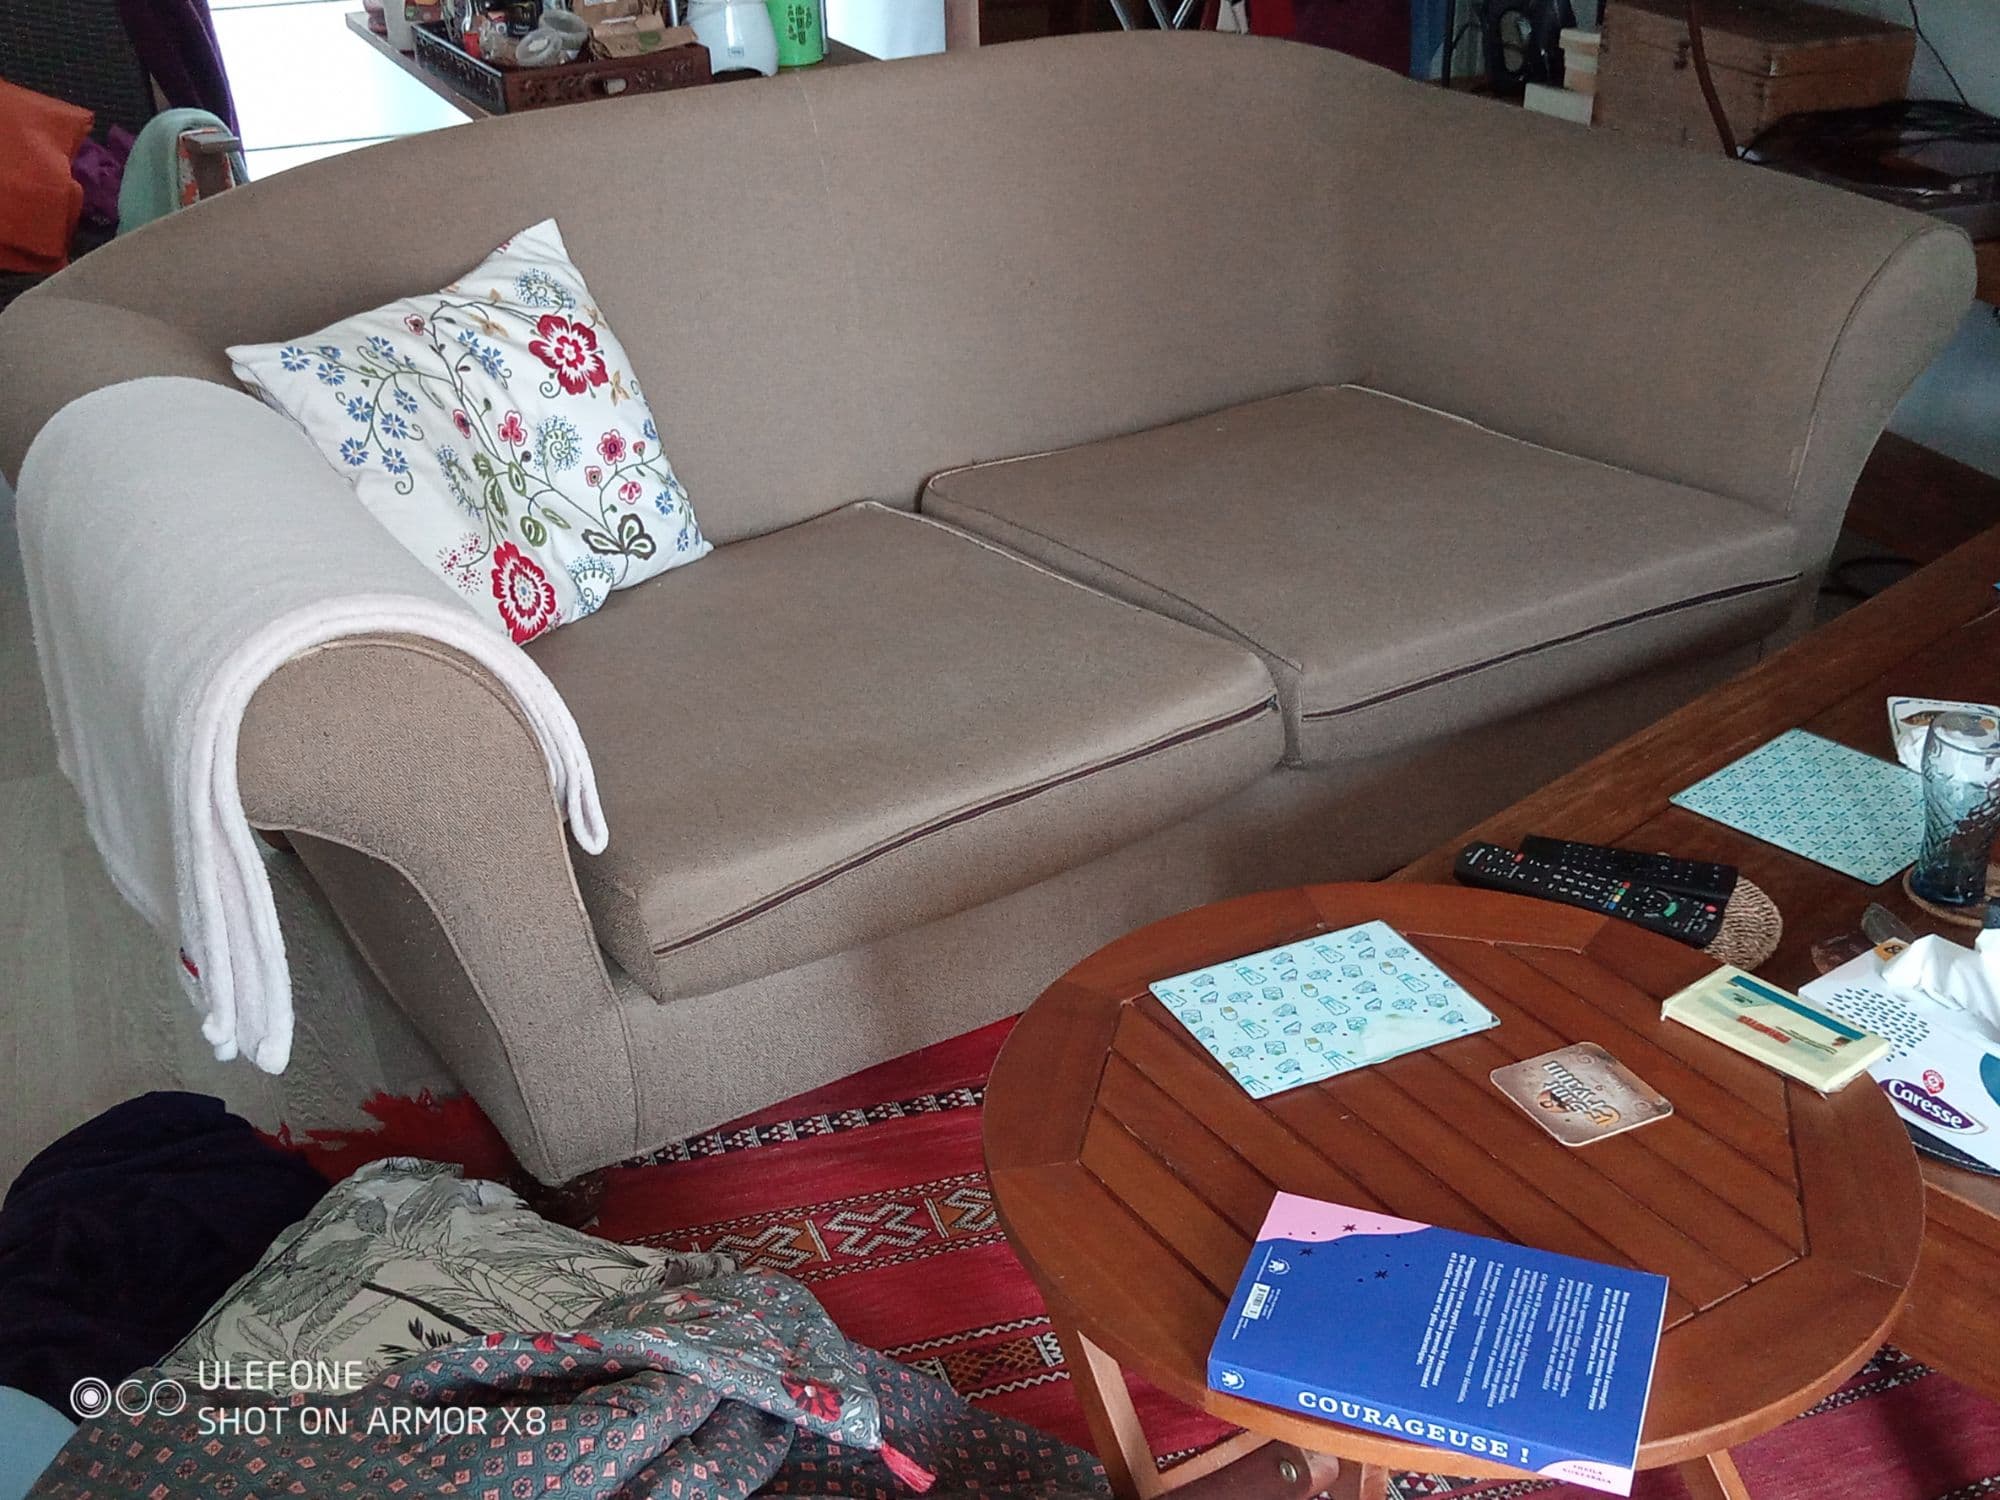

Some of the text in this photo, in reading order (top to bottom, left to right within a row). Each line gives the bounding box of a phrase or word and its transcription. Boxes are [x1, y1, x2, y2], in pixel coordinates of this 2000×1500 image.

[1888, 1080, 1963, 1128] Caresse
[1297, 1390, 1530, 1464] COURAGEUSE !
